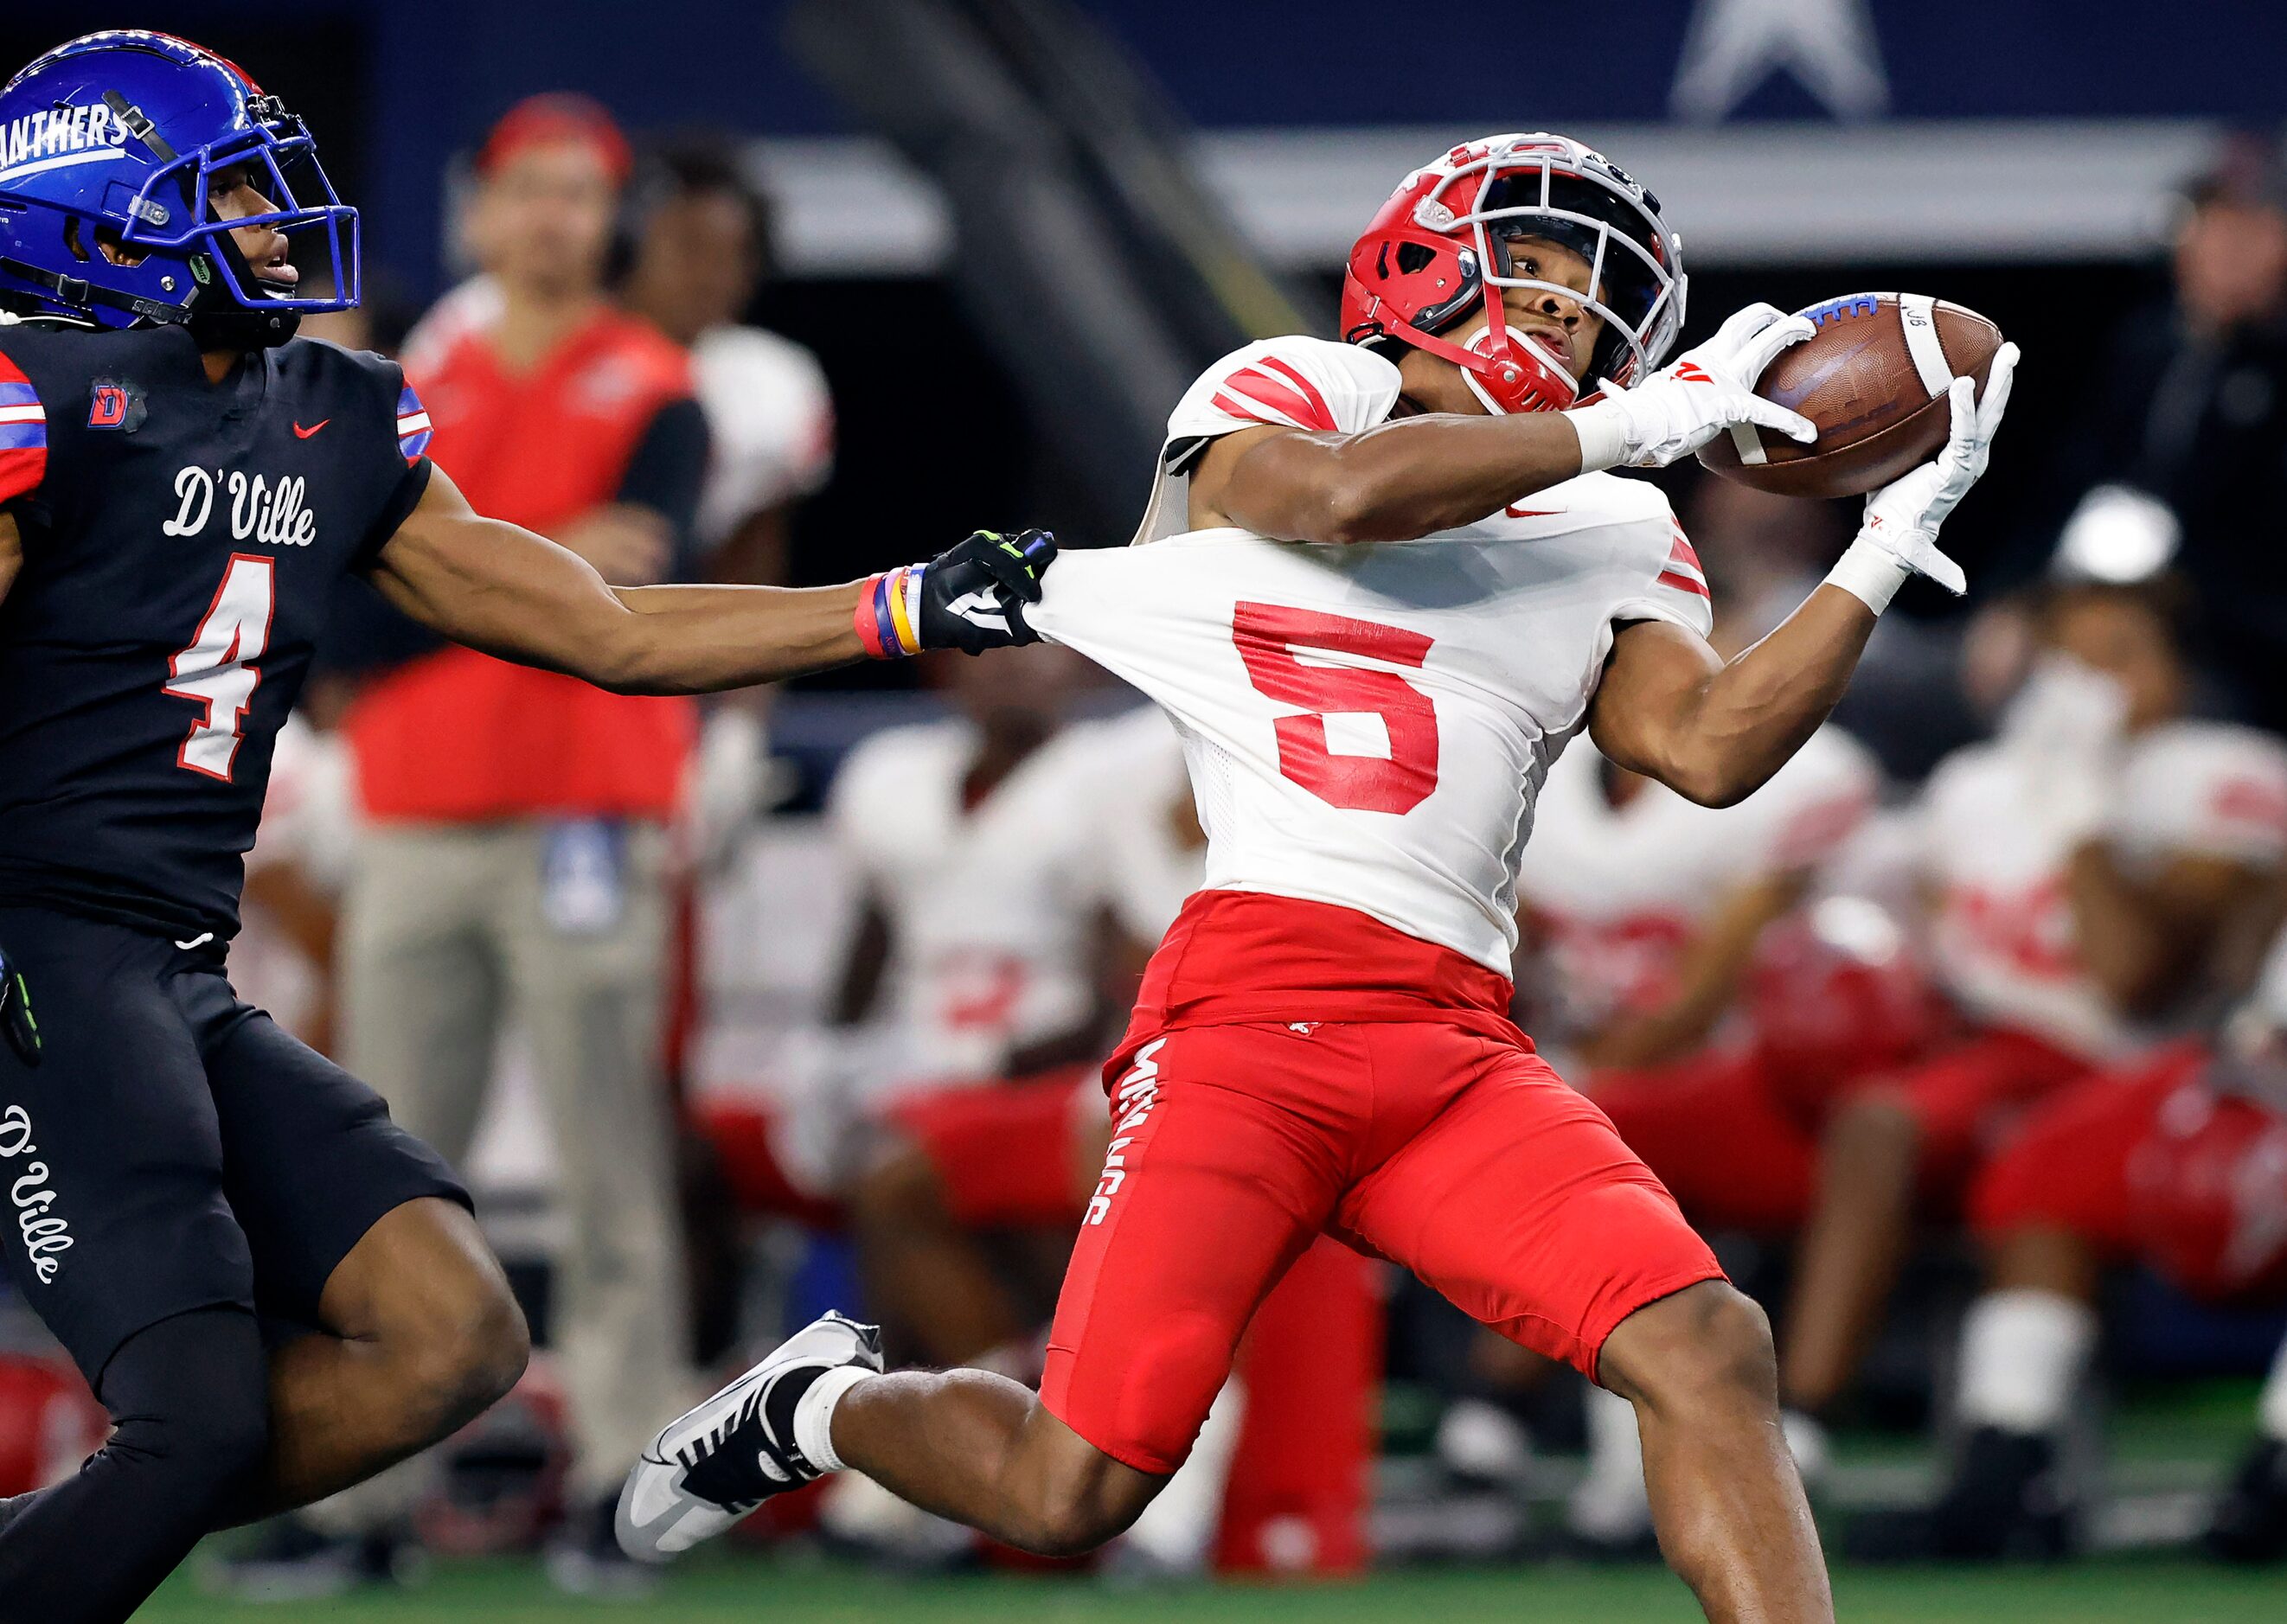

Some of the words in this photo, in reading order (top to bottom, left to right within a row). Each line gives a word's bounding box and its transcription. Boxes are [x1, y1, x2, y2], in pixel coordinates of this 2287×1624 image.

[87, 385, 127, 427] D
[162, 465, 317, 547] D'Ville
[162, 552, 275, 783] 4
[1233, 600, 1438, 815] 5
[0, 1104, 74, 1284] D'Ville
